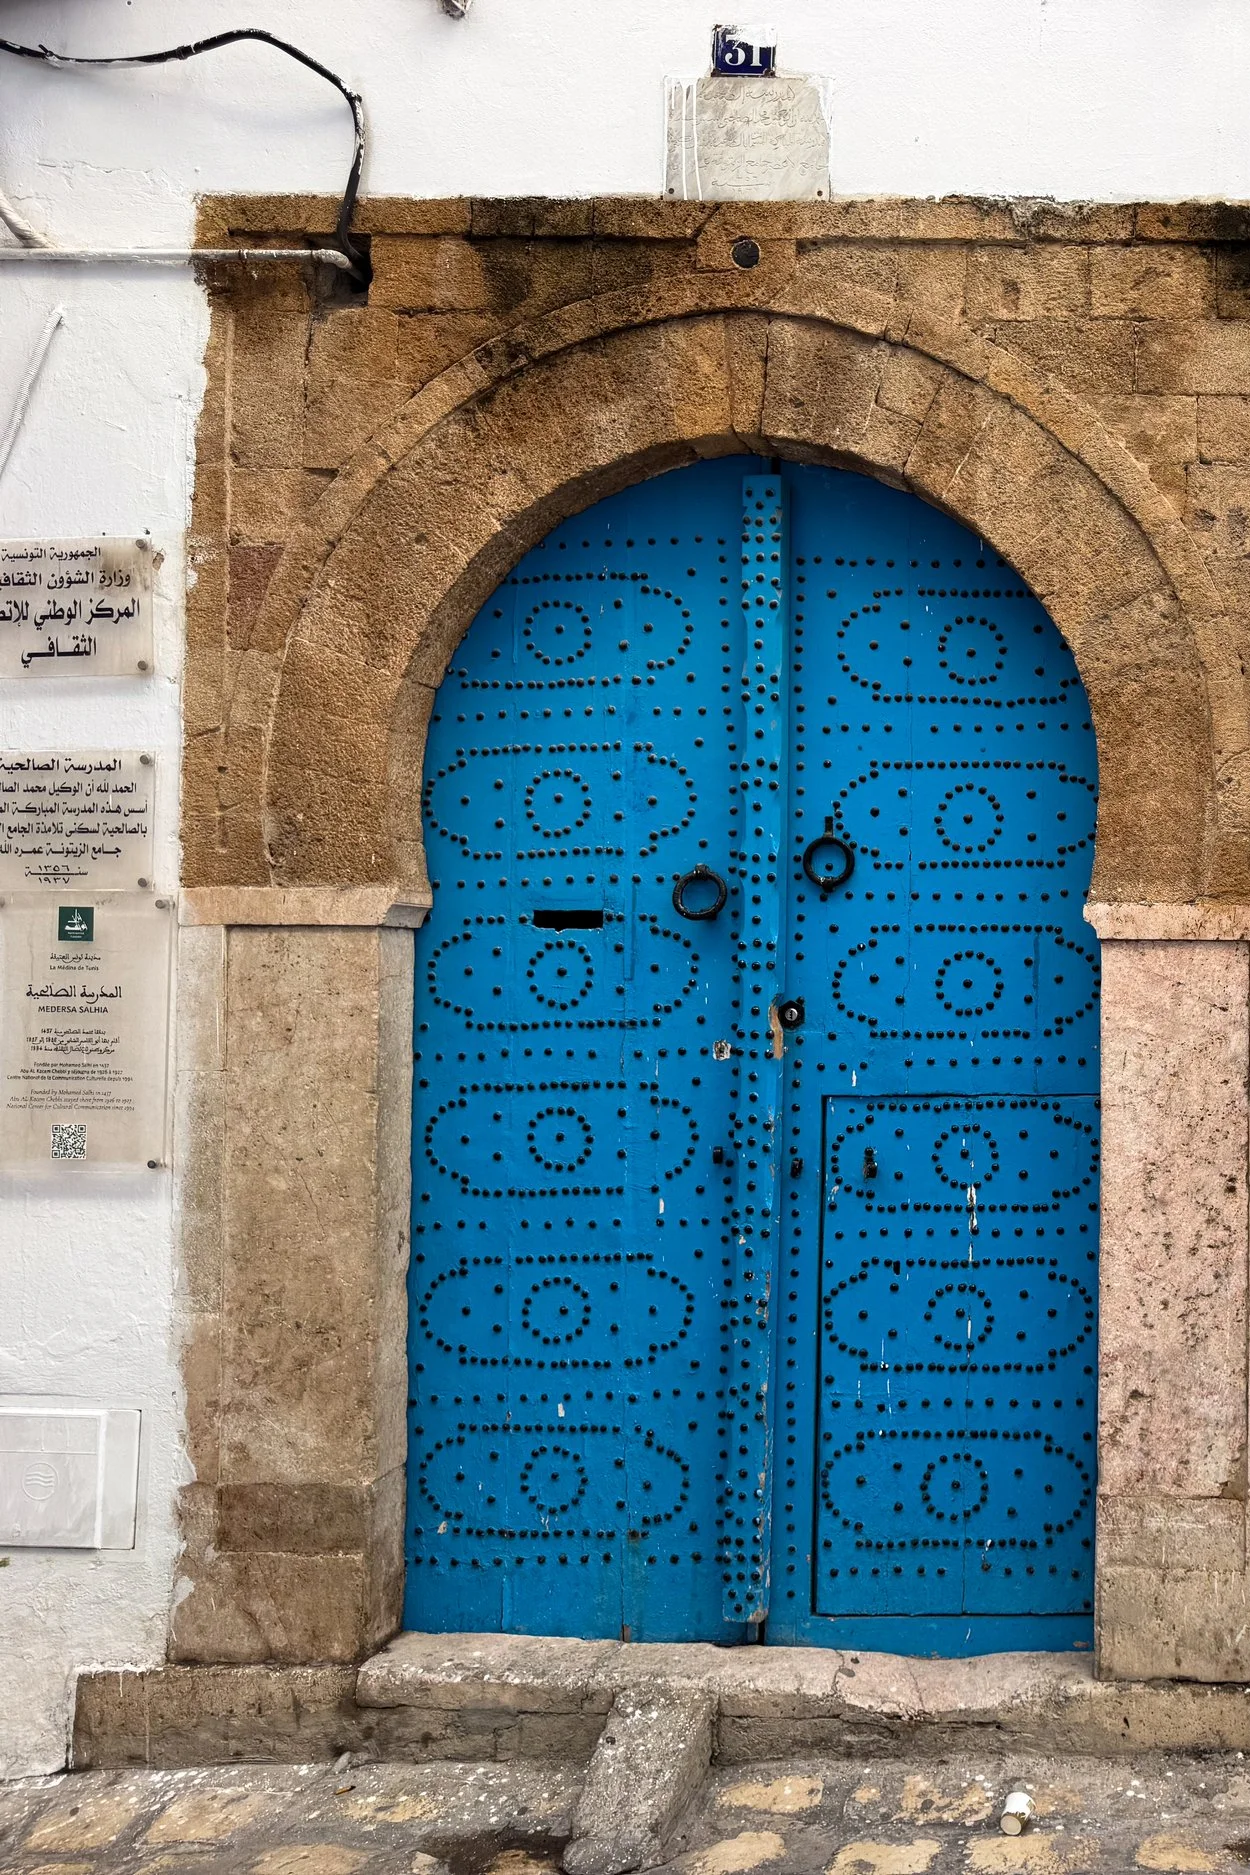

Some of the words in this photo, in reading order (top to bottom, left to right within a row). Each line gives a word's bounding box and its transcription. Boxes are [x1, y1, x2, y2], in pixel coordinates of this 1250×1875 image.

[724, 34, 763, 67] 31
[1, 547, 47, 562] التونسية
[49, 546, 101, 561] الجمهورية
[0, 571, 42, 591] الثقاف
[46, 569, 94, 590] الشؤون
[99, 569, 131, 587] وزارة
[33, 598, 82, 631] الوطني
[85, 597, 140, 625] المركز
[64, 757, 122, 774] المدرسة
[22, 783, 47, 793] محمد
[48, 781, 83, 797] الوكيل
[85, 779, 94, 797] أن
[96, 778, 109, 793] لله
[111, 782, 137, 793] الحمد
[12, 801, 60, 817] المباركة
[62, 801, 98, 817] المدرسة
[100, 801, 122, 814] هذه
[123, 800, 148, 817] أسس
[7, 822, 34, 840] الجامع
[36, 821, 64, 835] تلامذة
[102, 822, 148, 837] بالصالحية
[46, 842, 89, 858] الزيتونة
[91, 842, 122, 860] جامع
[80, 985, 122, 1004] المدرسة
[37, 1005, 77, 1013] MEDERSA
[79, 1006, 109, 1014] SALHIA
